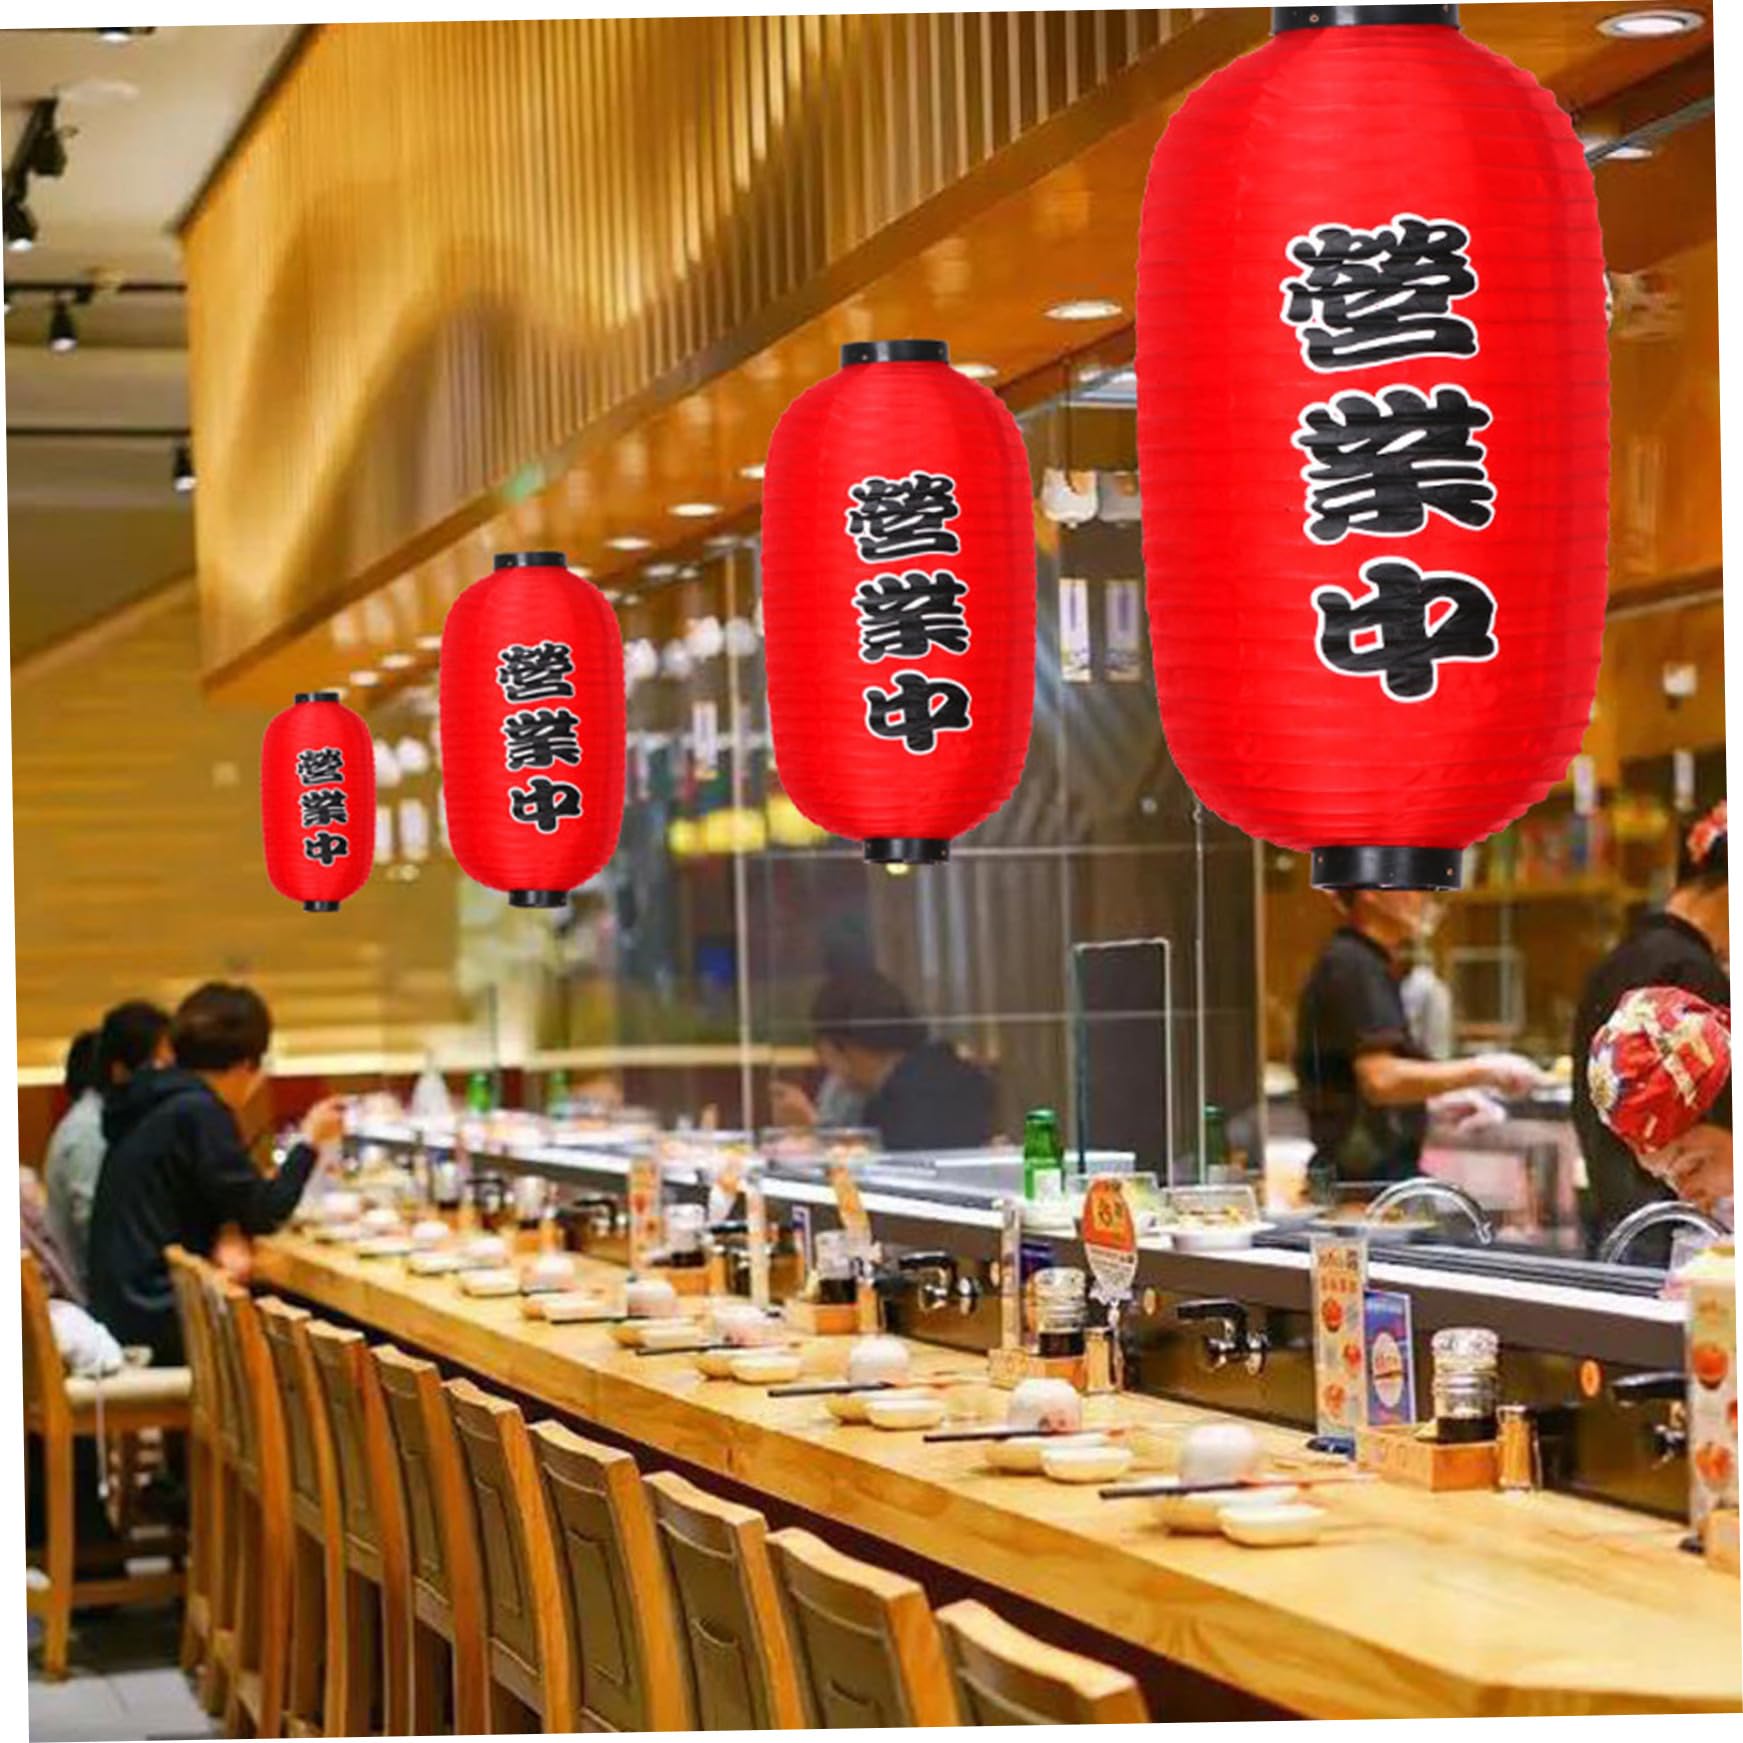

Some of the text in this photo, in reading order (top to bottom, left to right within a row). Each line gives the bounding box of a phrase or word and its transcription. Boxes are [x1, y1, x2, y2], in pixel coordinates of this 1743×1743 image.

[1281, 214, 1497, 702] 營業中
[846, 471, 971, 754] 營業中
[297, 748, 347, 865] 營業中
[497, 641, 582, 833] 營業中
